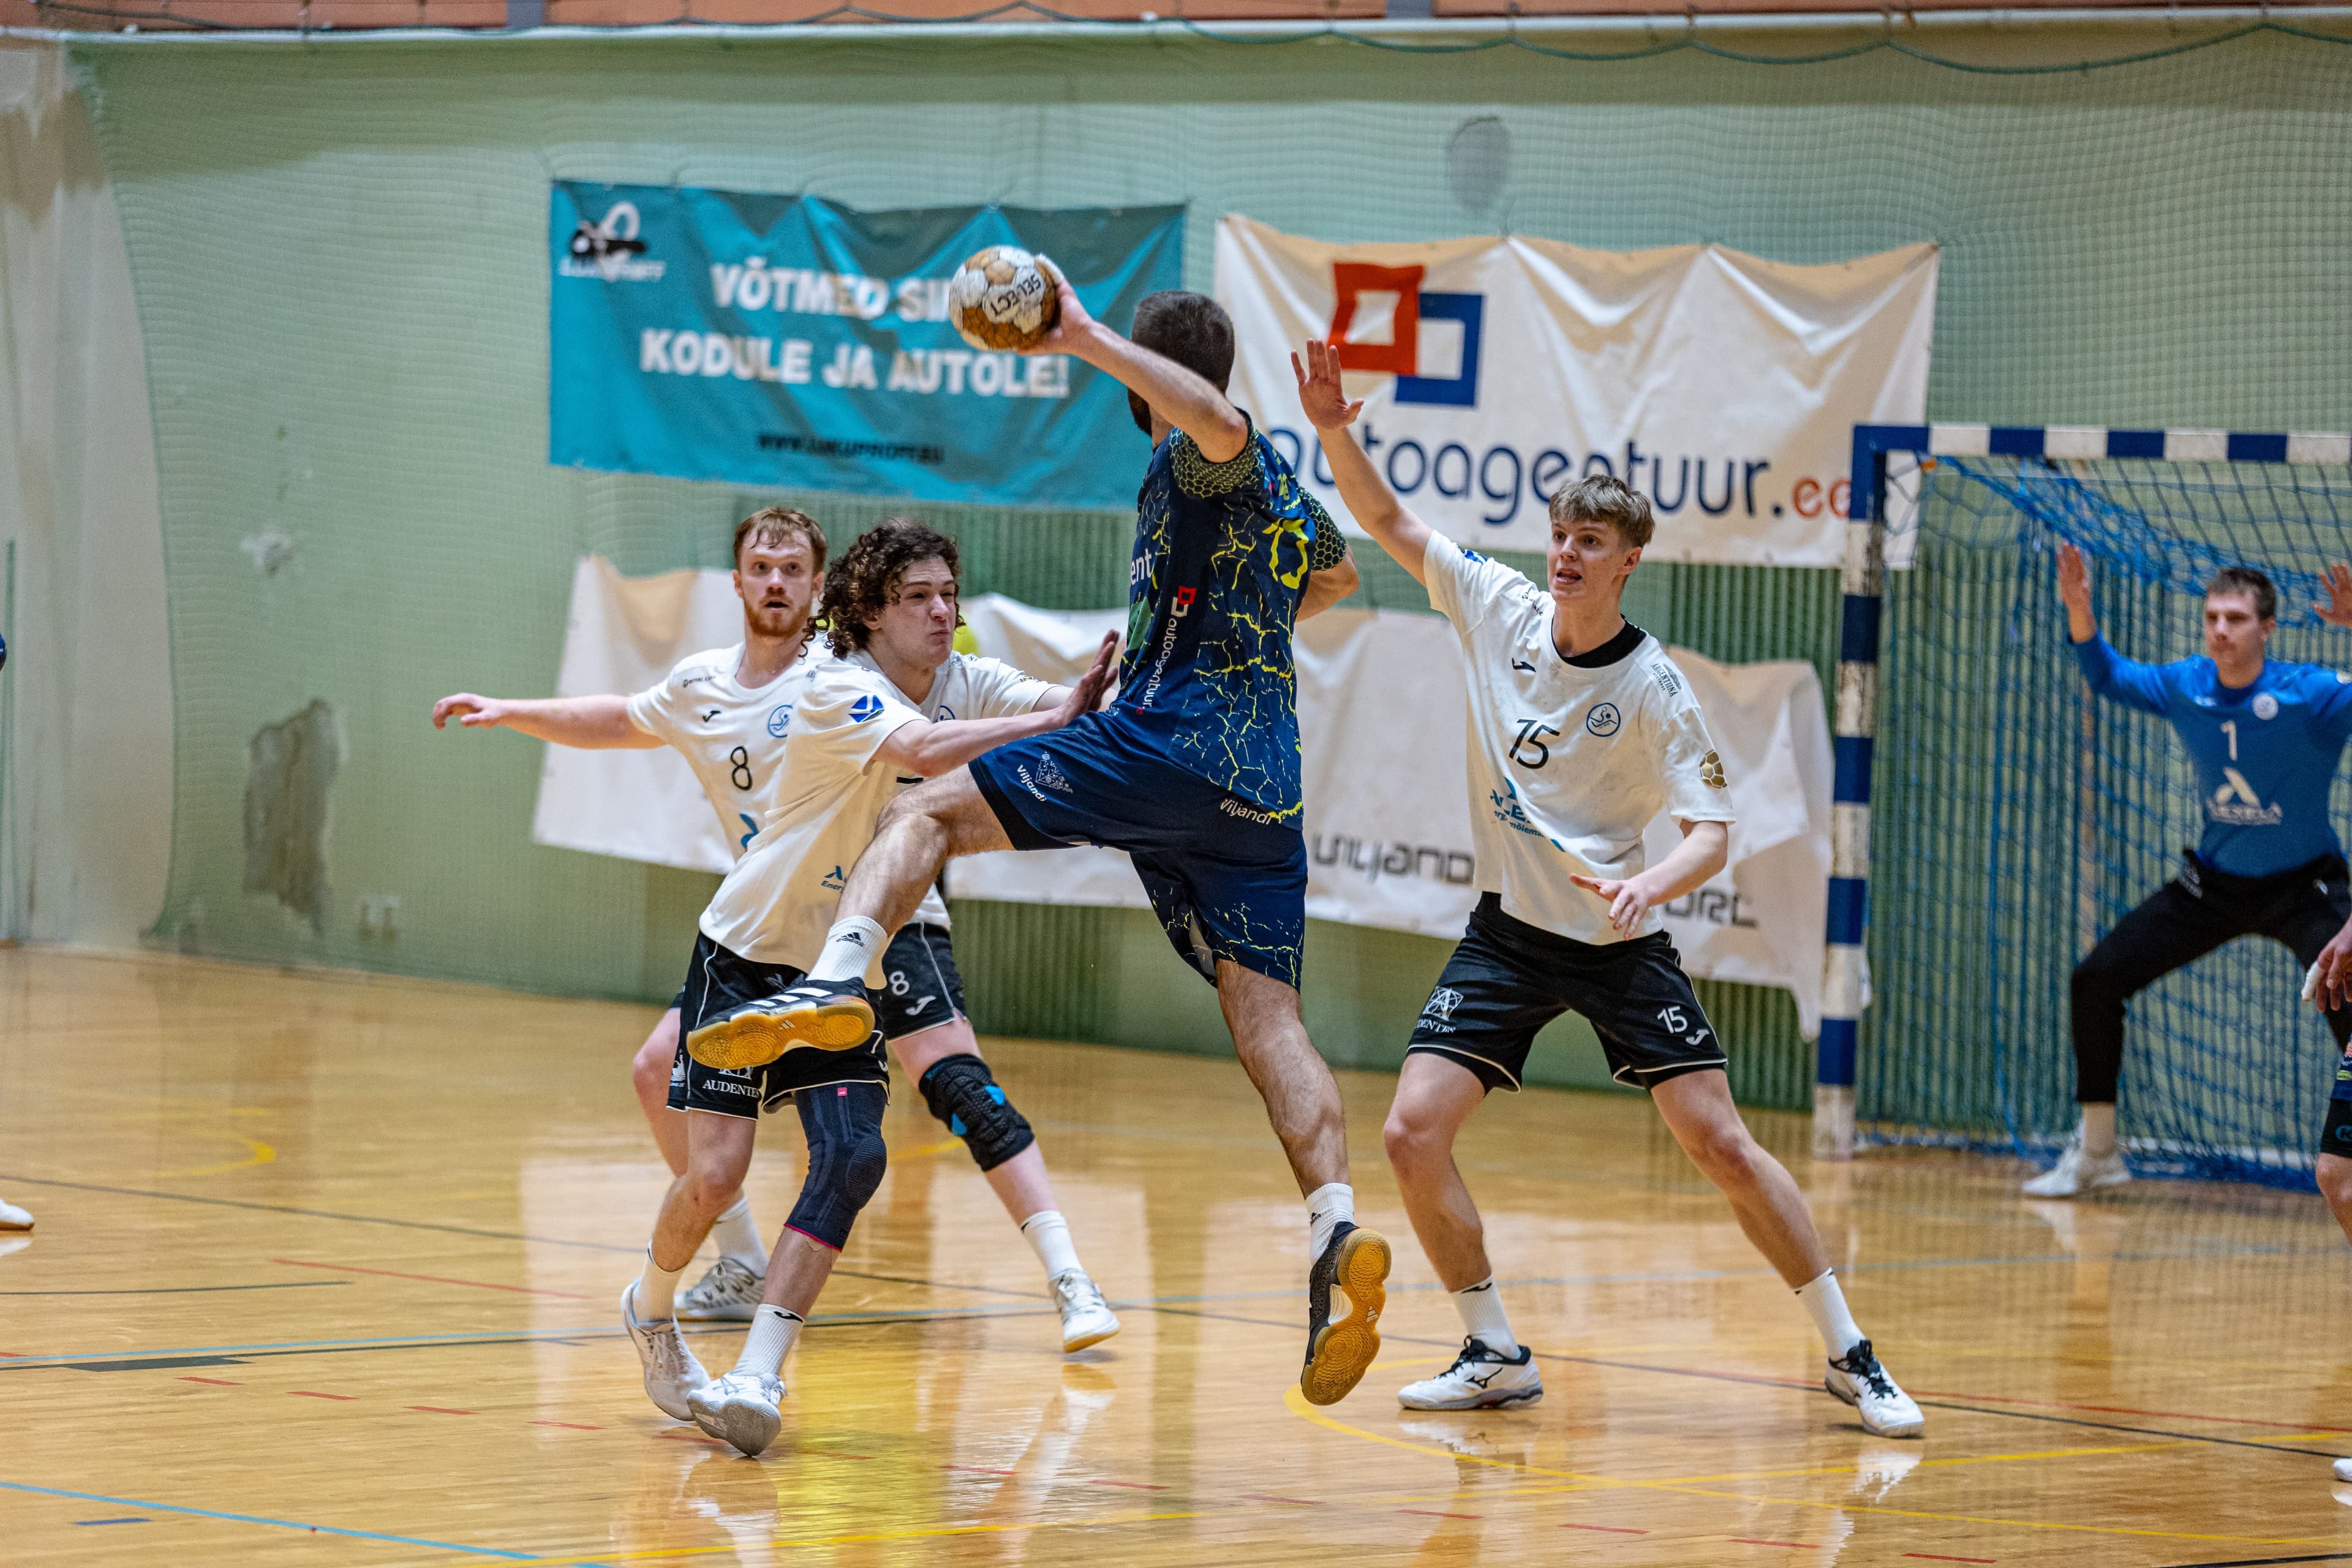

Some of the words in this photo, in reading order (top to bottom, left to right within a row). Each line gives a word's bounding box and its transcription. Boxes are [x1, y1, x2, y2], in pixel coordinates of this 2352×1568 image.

[710, 257, 889, 319] VÕTMED
[897, 277, 951, 322] SI
[641, 328, 813, 384] KODULE
[823, 344, 878, 391] JA
[887, 349, 1071, 399] AUTOLE!
[1509, 719, 1561, 769] 15
[2220, 720, 2237, 761] 1
[730, 745, 753, 791] 8
[1017, 764, 1047, 801] Viljandi
[889, 970, 910, 996] 8
[1657, 1006, 1689, 1034] 15
